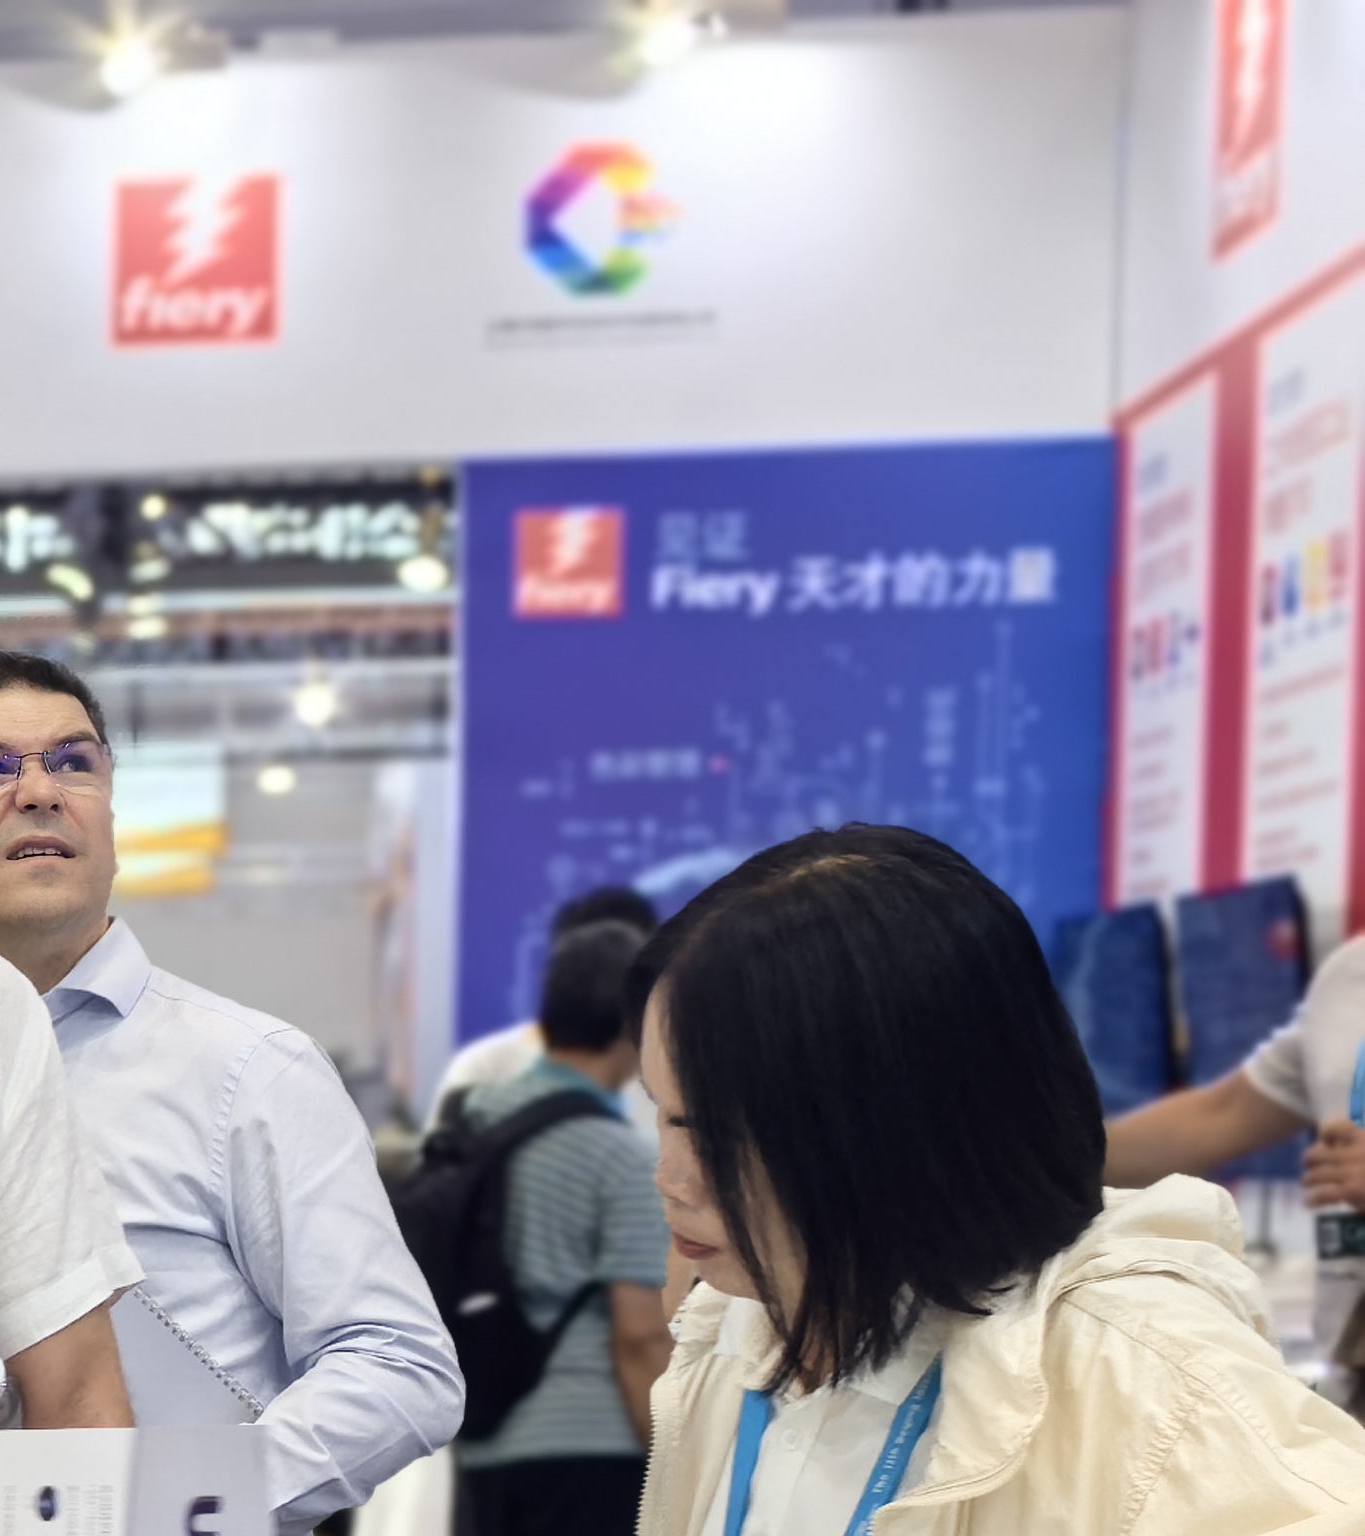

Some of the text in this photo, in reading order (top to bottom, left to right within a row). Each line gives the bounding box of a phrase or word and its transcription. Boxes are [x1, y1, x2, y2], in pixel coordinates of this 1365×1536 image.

[119, 277, 273, 344] fiery
[651, 546, 1057, 616] Fiery 天才的力量
